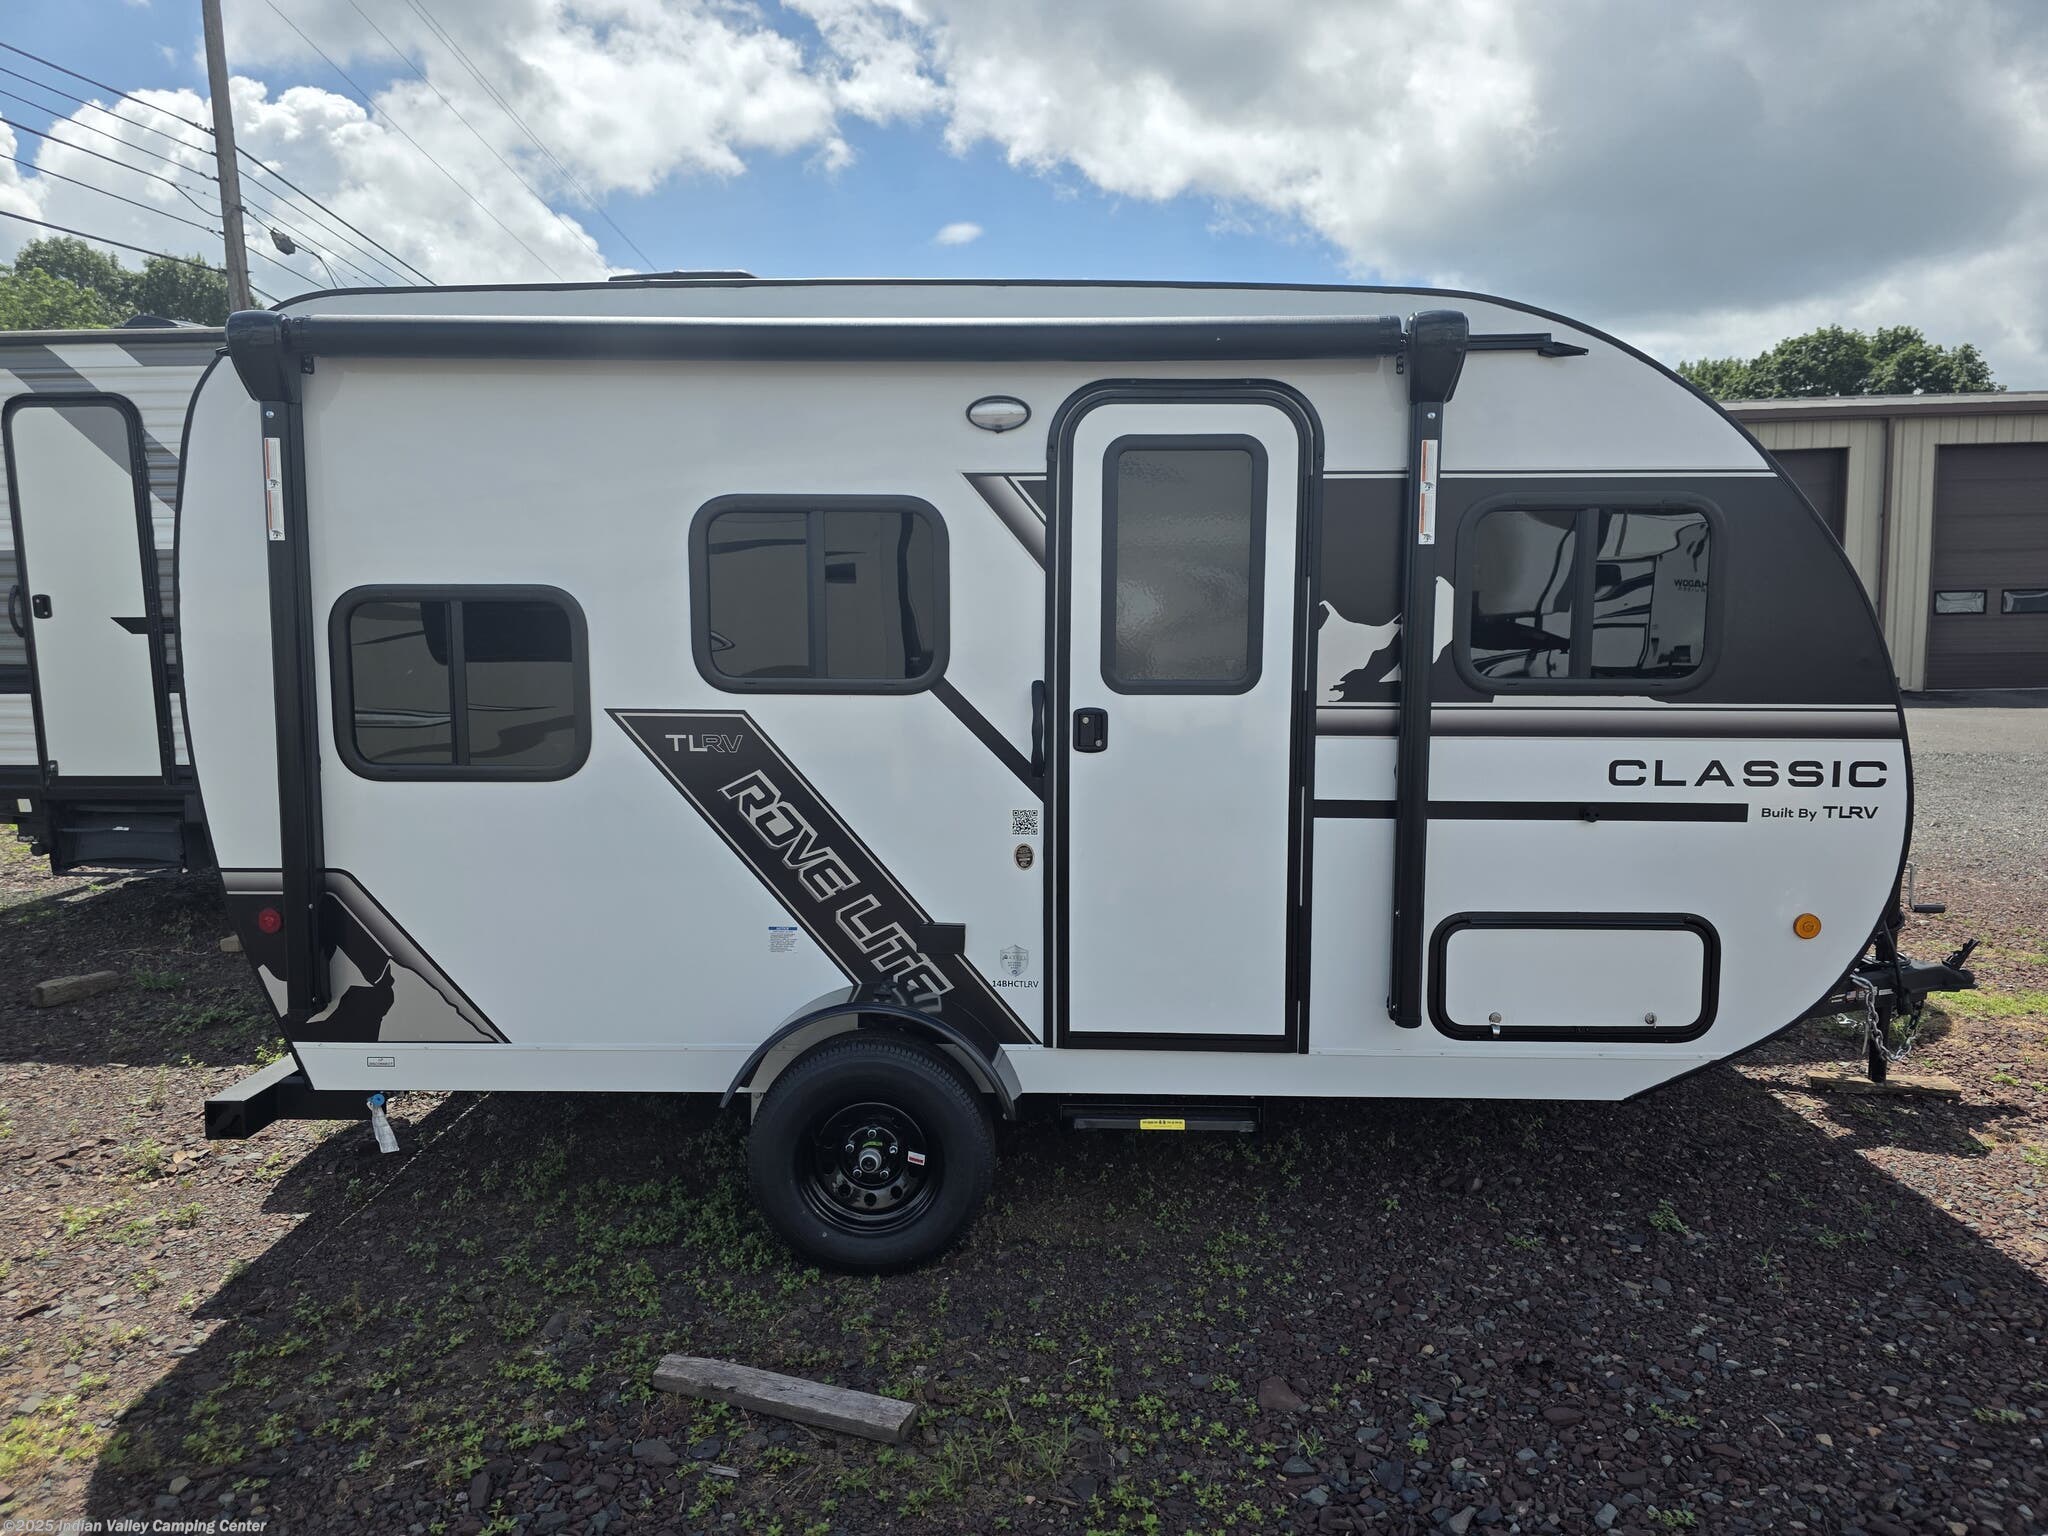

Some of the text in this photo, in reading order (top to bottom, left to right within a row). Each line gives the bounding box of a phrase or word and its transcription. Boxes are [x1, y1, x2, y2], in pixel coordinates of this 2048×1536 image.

[665, 734, 743, 753] TLRV
[1608, 759, 1888, 788] CLASSIC
[1761, 806, 1879, 822] Built By TLRV
[717, 769, 955, 1011] ROVE LITE
[992, 980, 1039, 988] 14BHCTLRV
